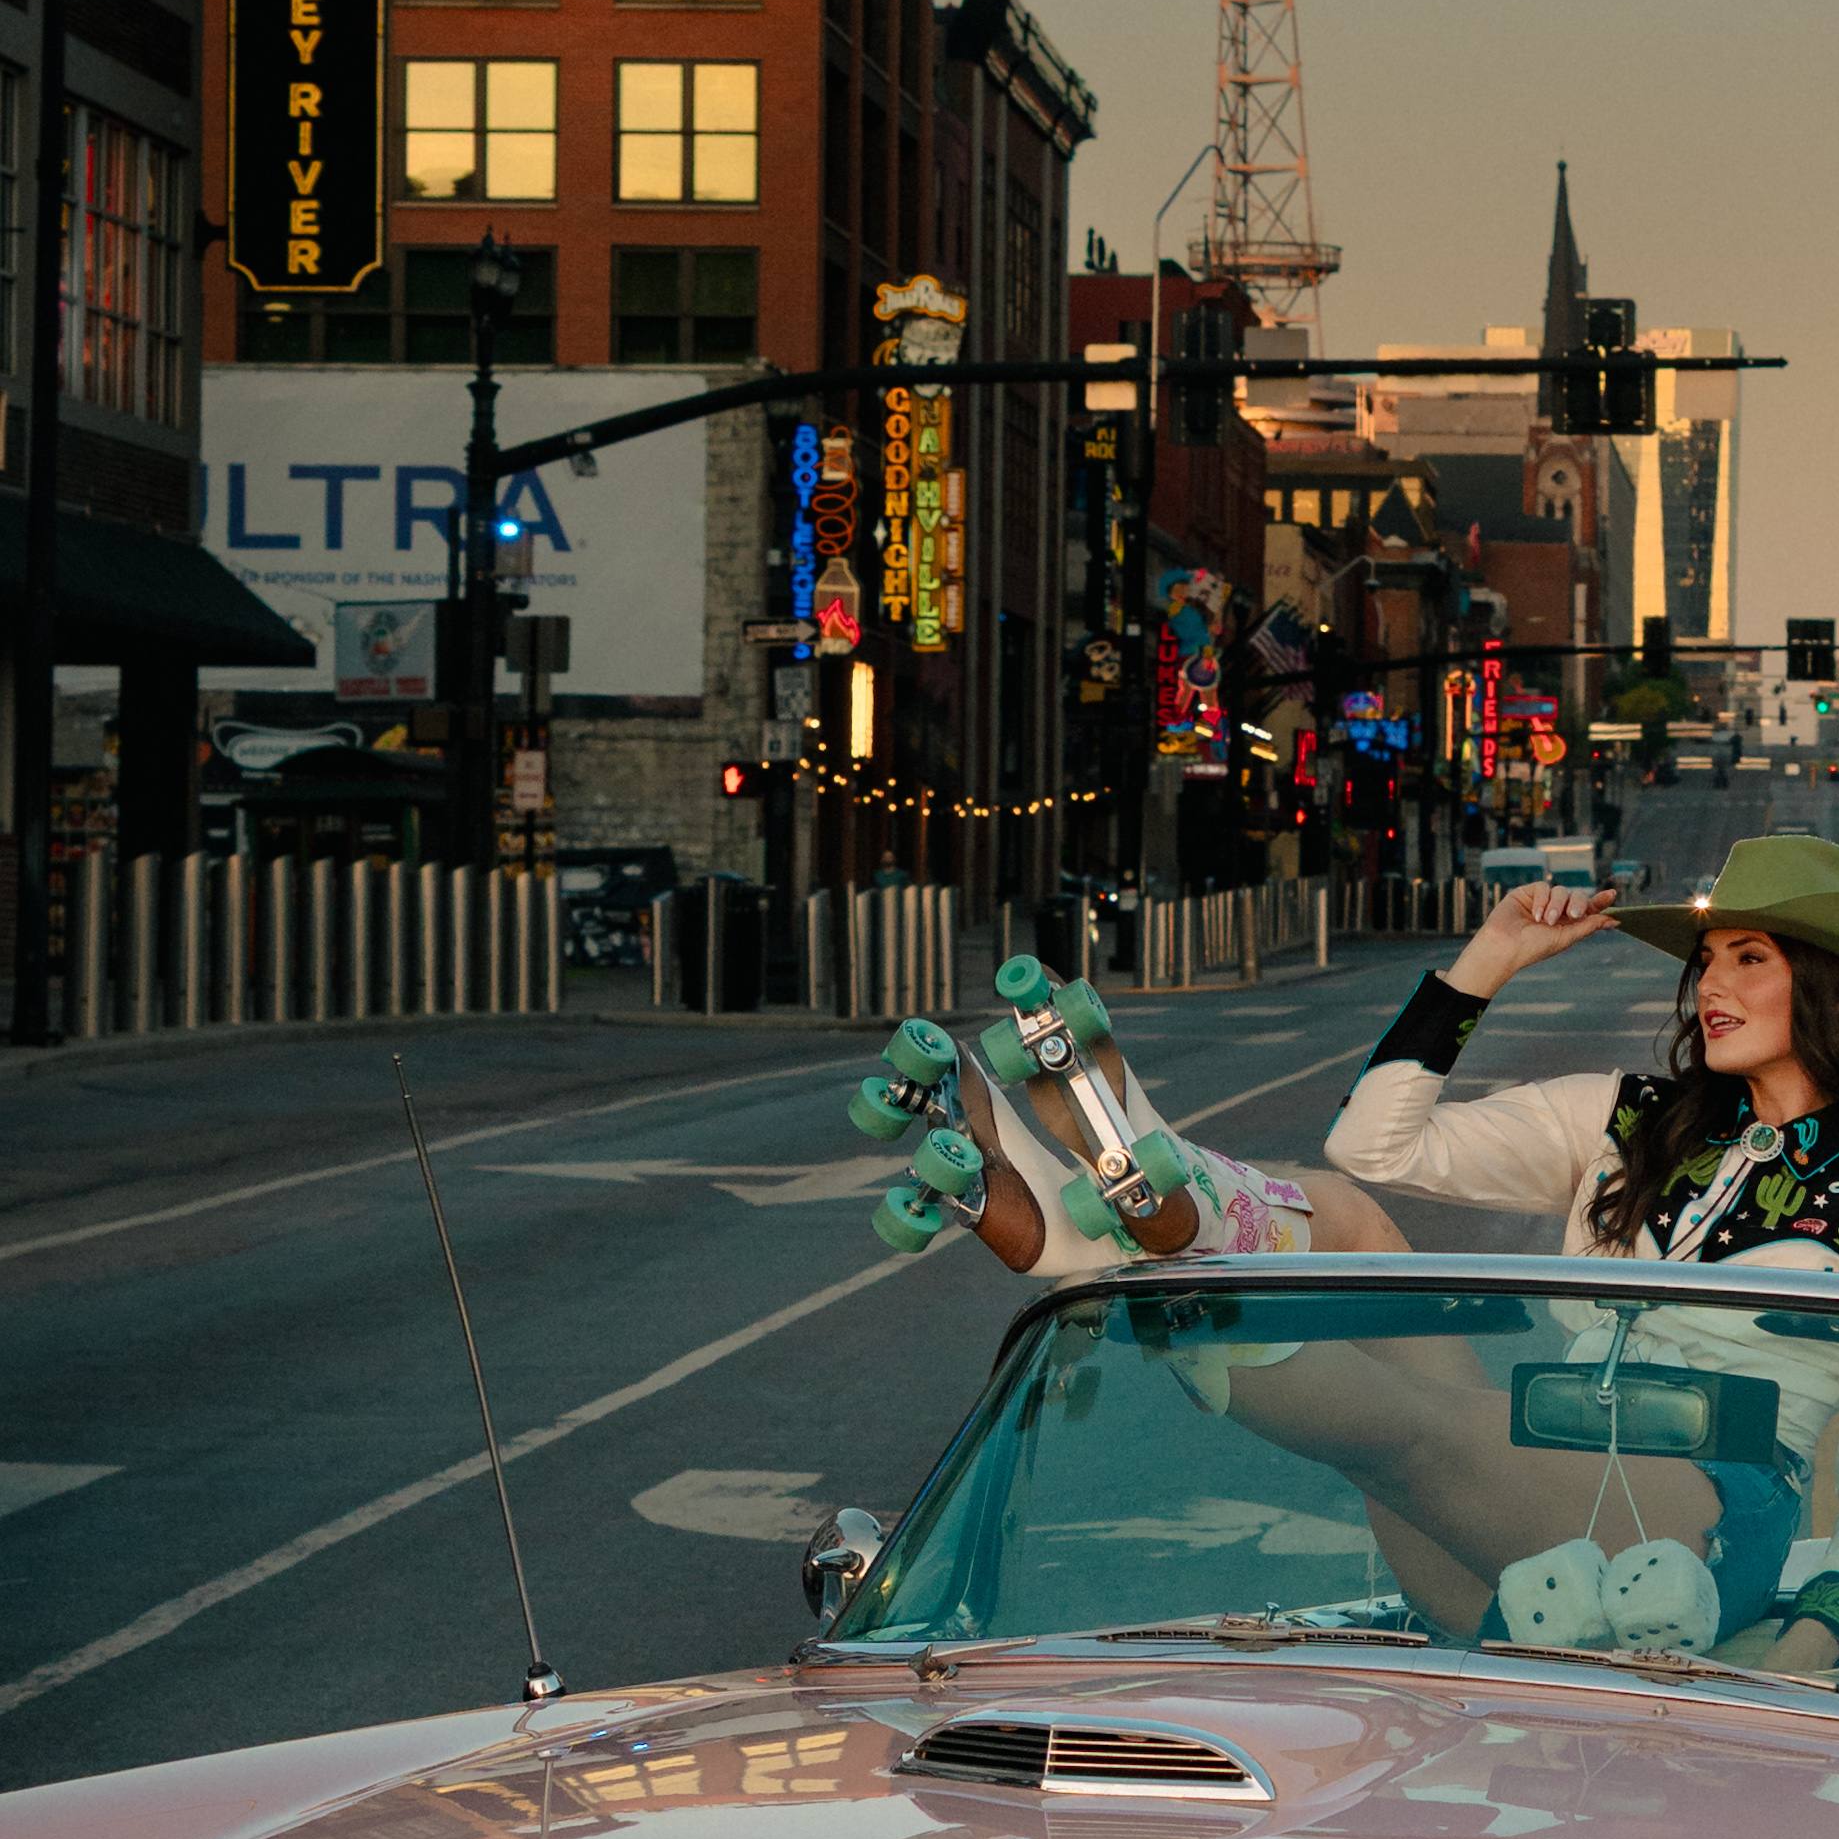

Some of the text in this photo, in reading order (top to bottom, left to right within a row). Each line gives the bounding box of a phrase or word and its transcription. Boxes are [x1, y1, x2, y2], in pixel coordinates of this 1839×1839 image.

[287, 82, 322, 274] RIVER
[200, 464, 571, 552] LTRA
[883, 386, 910, 621] GOODNIGHT
[341, 572, 360, 587] OF
[367, 572, 396, 587] THE
